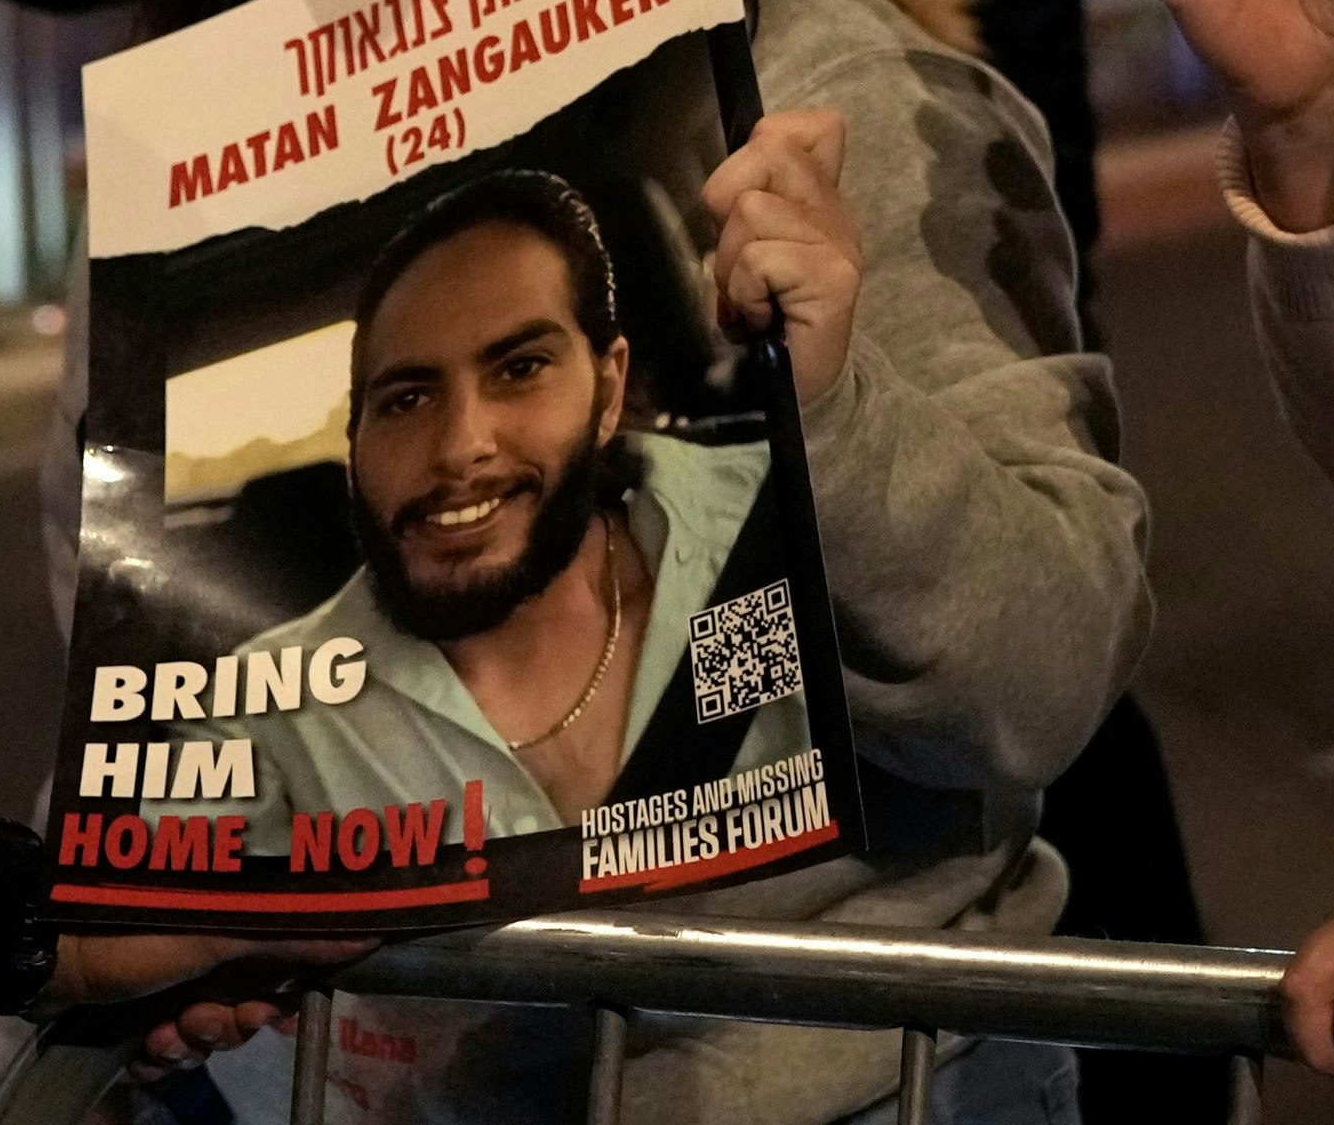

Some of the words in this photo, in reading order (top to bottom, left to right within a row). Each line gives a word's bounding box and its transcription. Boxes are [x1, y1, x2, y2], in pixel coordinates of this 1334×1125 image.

[168, 103, 340, 209] MATAN
[385, 107, 467, 177] (24)
[90, 637, 368, 723] BRING
[79, 738, 256, 799] HIM
[581, 788, 688, 839] HOSTAGES
[692, 777, 731, 816] AND
[736, 748, 824, 807] MISSING
[58, 812, 247, 874] HOME
[582, 814, 720, 881] FAMILIES
[726, 781, 831, 855] FORUM
